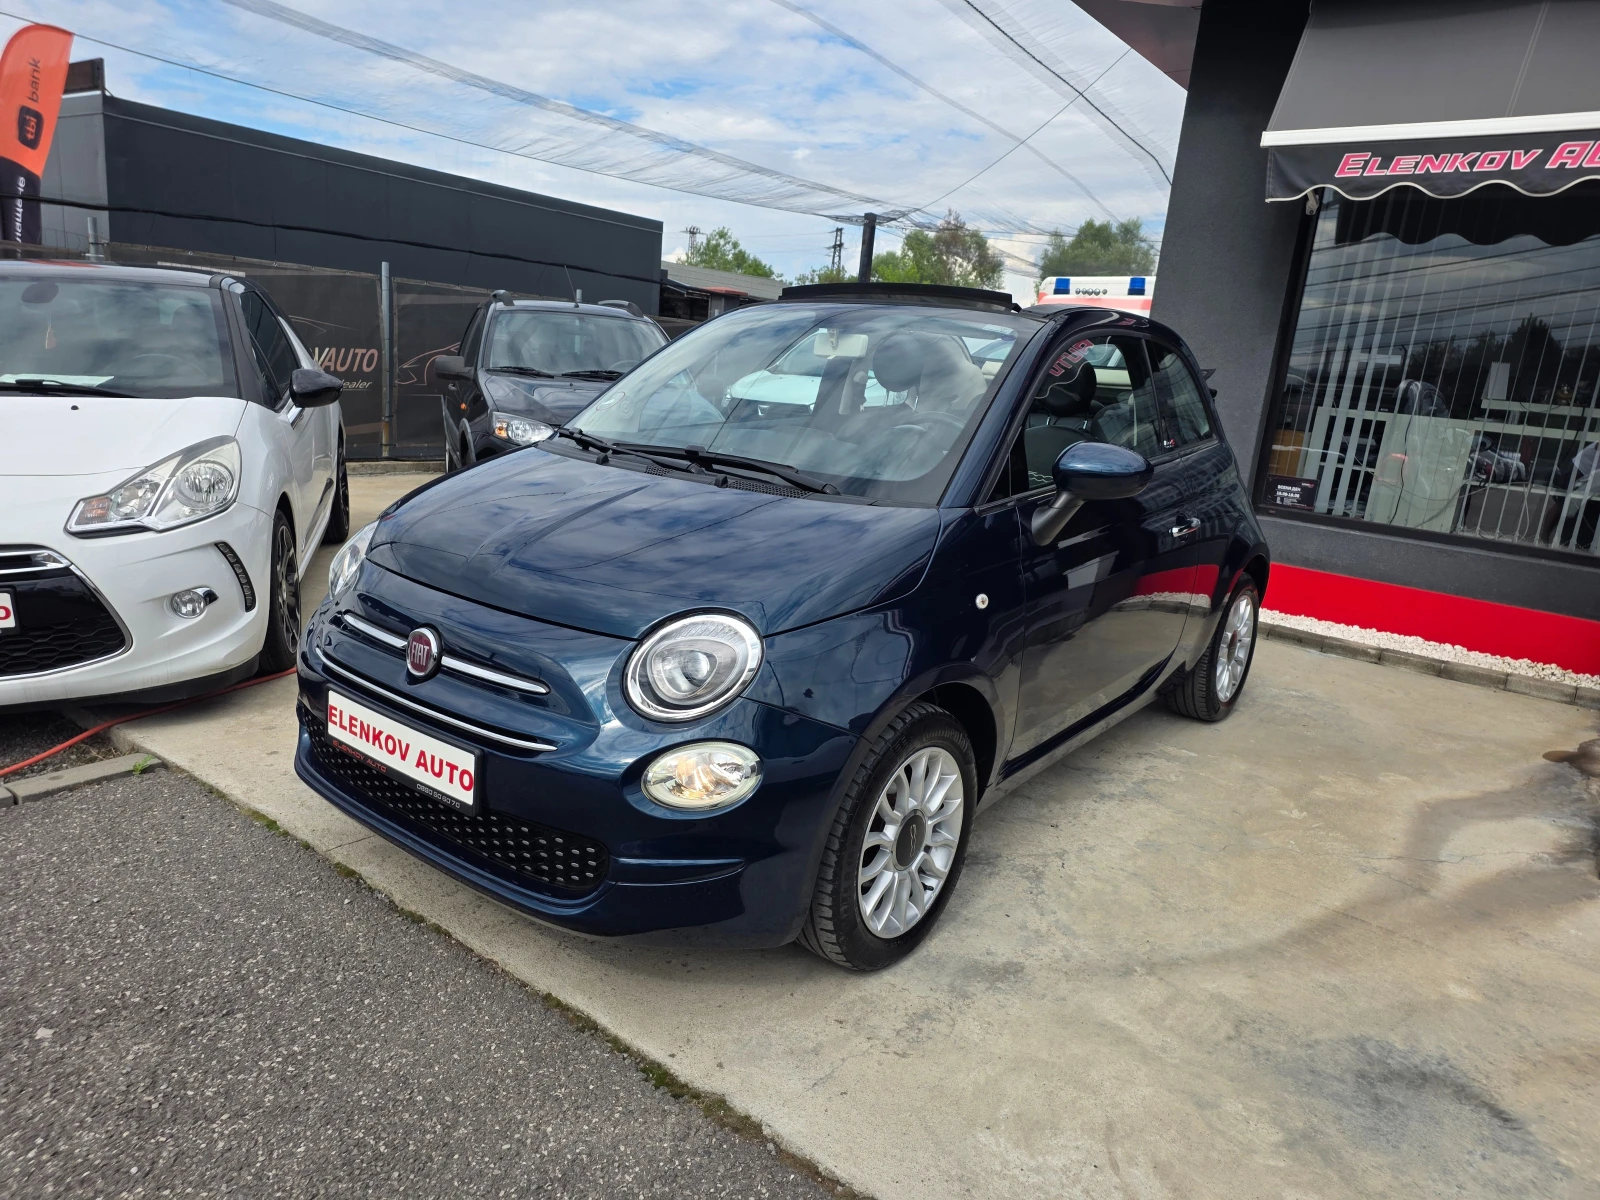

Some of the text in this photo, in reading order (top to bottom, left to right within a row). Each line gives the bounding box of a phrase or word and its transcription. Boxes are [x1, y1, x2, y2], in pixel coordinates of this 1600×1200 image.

[27, 57, 41, 103] bank
[1335, 149, 1544, 177] ELENKOV
[411, 641, 430, 666] FIAT
[328, 704, 474, 792] ELENKOV AUTO
[366, 758, 387, 773] AUTO
